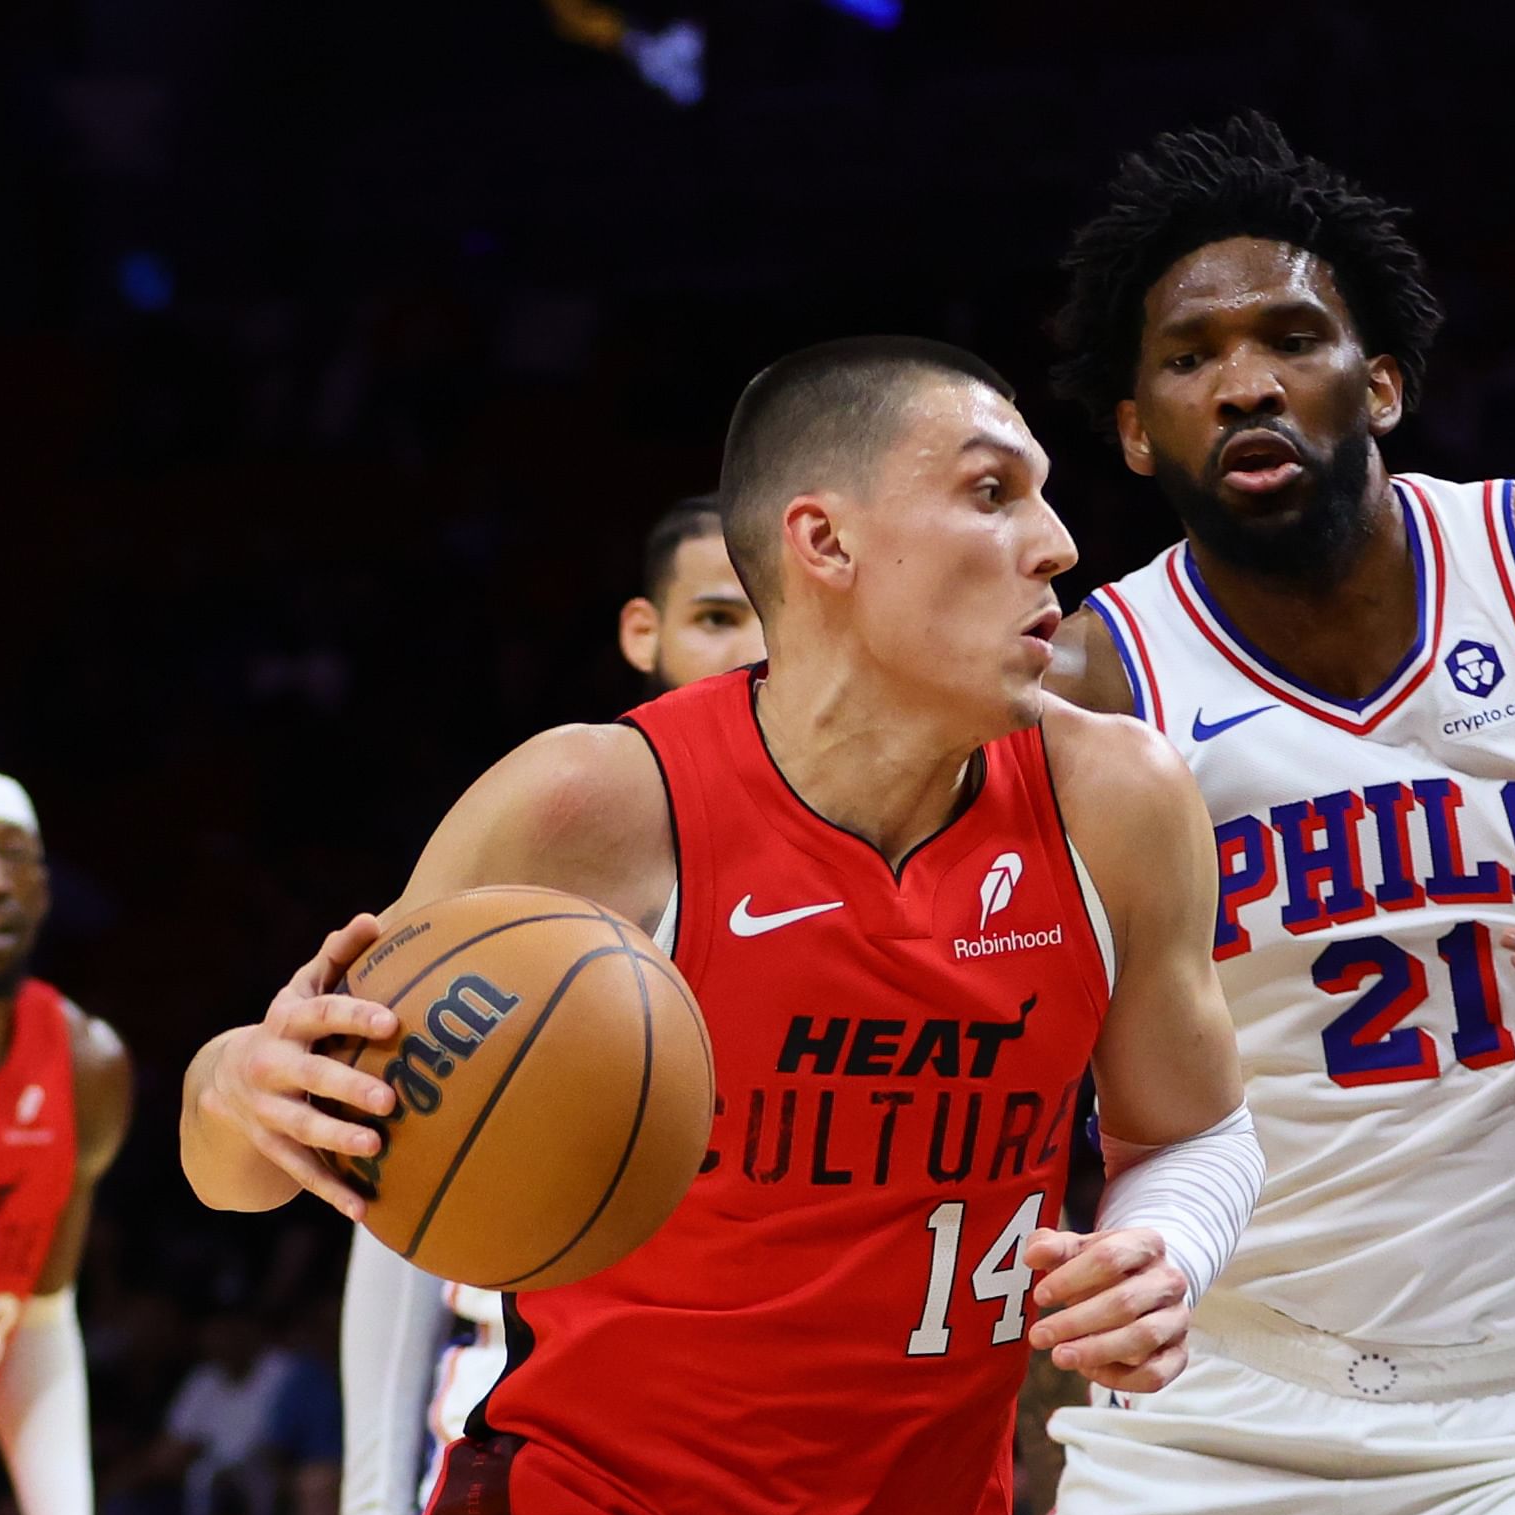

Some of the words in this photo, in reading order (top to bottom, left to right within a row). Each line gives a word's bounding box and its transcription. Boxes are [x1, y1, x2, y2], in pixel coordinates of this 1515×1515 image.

[953, 923, 1063, 960] Robinhood
[775, 992, 1038, 1079] HEAT
[907, 1187, 1046, 1357] 14
